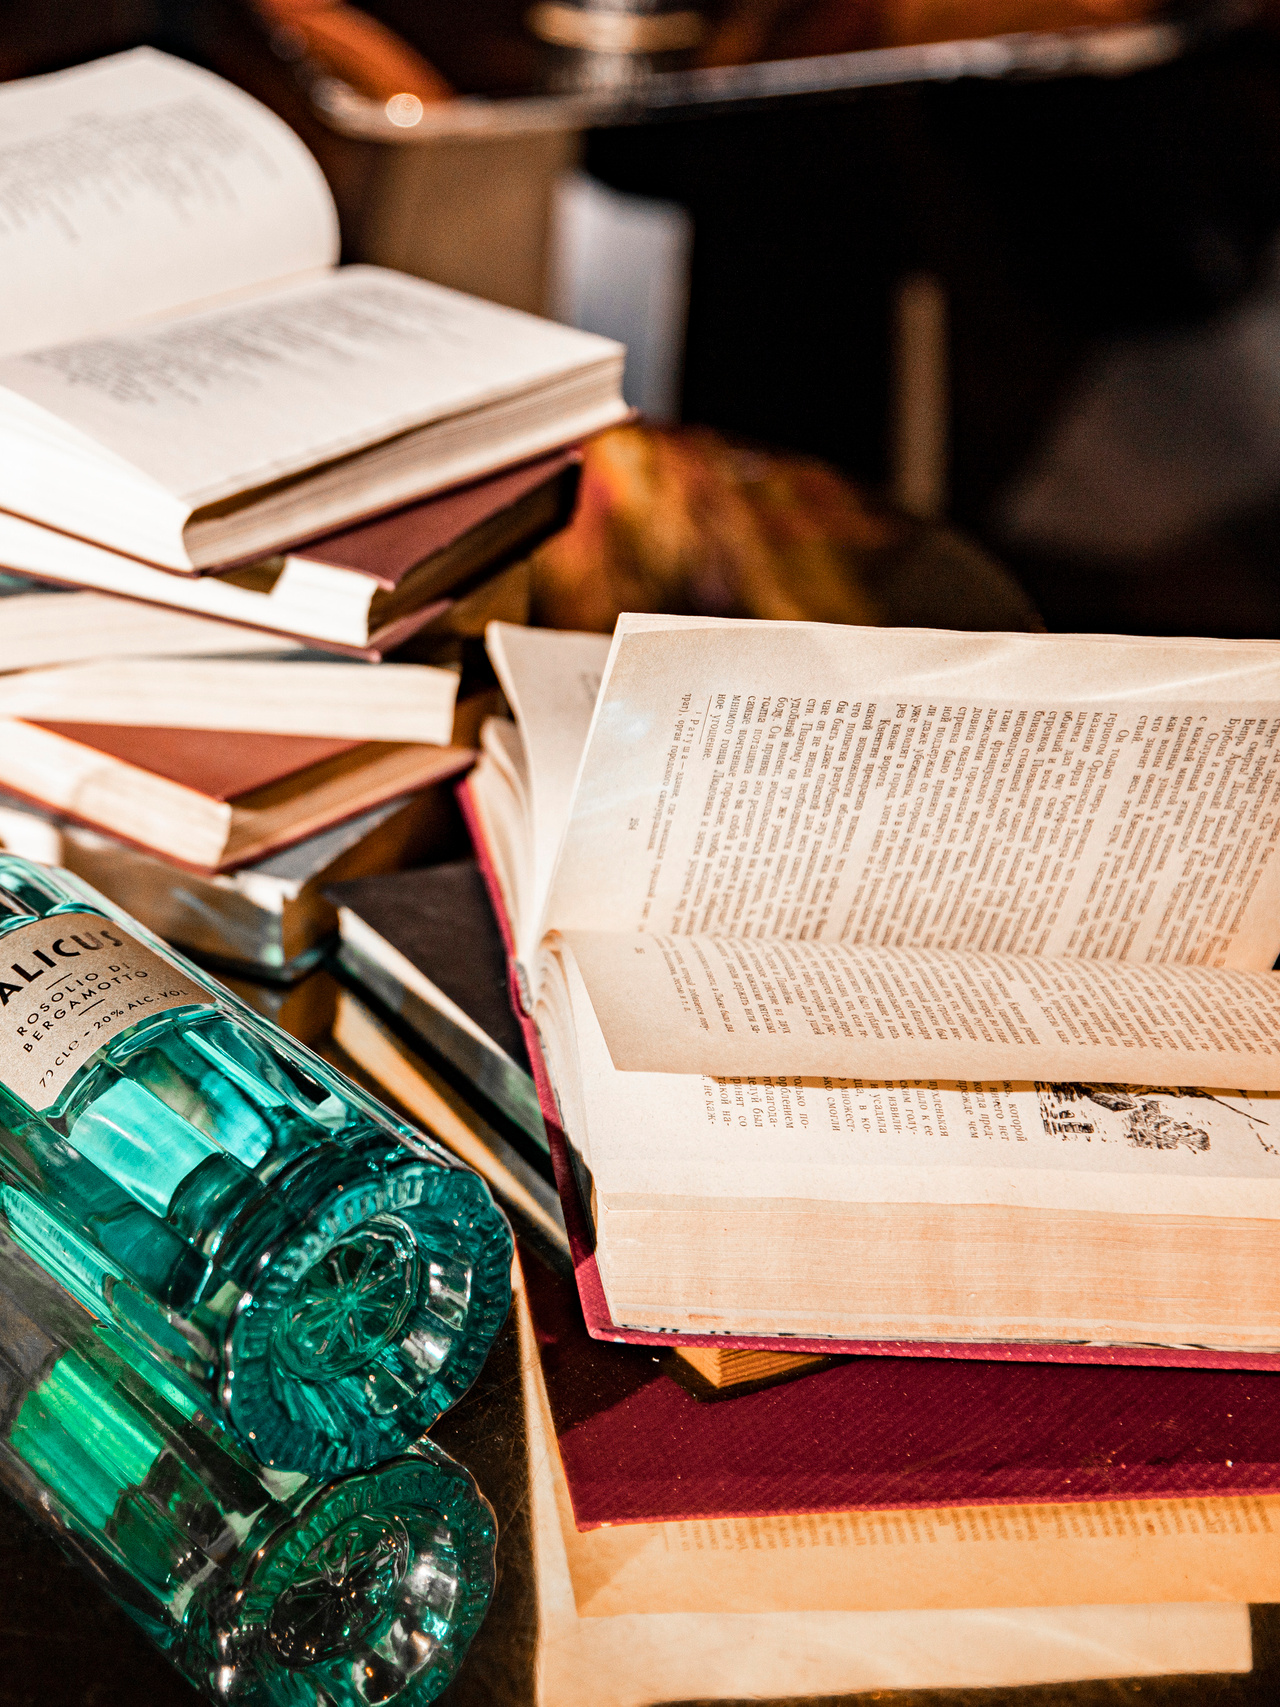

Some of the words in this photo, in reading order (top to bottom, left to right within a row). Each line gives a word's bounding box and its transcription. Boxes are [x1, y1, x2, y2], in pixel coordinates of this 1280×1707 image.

[715, 693, 726, 710] ное
[724, 695, 742, 734] мнимого
[741, 695, 756, 724] самые
[757, 696, 772, 723] толпа
[805, 698, 817, 714] сти.
[820, 699, 832, 716] чае
[850, 702, 862, 718] что
[862, 703, 877, 731] какой
[895, 703, 908, 719] рез
[909, 704, 922, 723] уже
[940, 706, 953, 723] ной
[673, 720, 685, 741] орган
[783, 698, 802, 737] удобный
[828, 718, 844, 741] быть
[918, 720, 932, 745] даже
[949, 706, 967, 743] стрелка
[965, 707, 983, 741] довика
[998, 709, 1013, 732] тами
[1025, 710, 1046, 743] близко
[1036, 710, 1058, 753] стрелков.
[1051, 710, 1073, 753] обычный
[1069, 711, 1088, 743] шлема
[1082, 712, 1103, 753] казанию
[1131, 715, 1148, 743] ствий.
[1151, 716, 1164, 732] что
[1165, 715, 1179, 733] как
[1235, 718, 1257, 747] Вепрь
[1254, 718, 1268, 736] или
[702, 715, 721, 760] угощение.
[792, 723, 813, 762] Поэтому
[838, 723, 856, 761] попытка
[869, 719, 891, 758] Квентин
[886, 724, 902, 750] какие
[899, 727, 916, 759] входят
[974, 708, 998, 761] льежскими
[1000, 710, 1028, 773] недовольство
[1095, 712, 1118, 756] герцогом
[1165, 716, 1193, 771] отдаленных
[1183, 727, 1204, 762] каждой
[1215, 718, 1242, 757] Бурбона
[716, 739, 730, 765] гонца
[728, 729, 748, 777] почтенные
[743, 729, 763, 774] потащила
[758, 743, 774, 776] принял
[803, 751, 817, 778] видел
[820, 744, 834, 770] даже
[923, 727, 946, 778] поддержки
[940, 749, 956, 774] было
[952, 746, 971, 782] оказать
[1062, 750, 1074, 766] дал
[1102, 749, 1120, 780] только
[1137, 738, 1156, 769] значит
[1152, 739, 1170, 768] волны
[1186, 732, 1219, 792] Оглушенный
[1239, 741, 1259, 775] смерть!
[843, 737, 867, 798] возможности
[875, 755, 892, 787] ворота.
[975, 740, 1005, 804] французского
[1009, 748, 1030, 792] стоявшей
[1038, 769, 1053, 790] всем
[1054, 773, 1066, 789] ему
[1069, 759, 1086, 787] лорда
[1203, 772, 1215, 787] его
[1245, 756, 1268, 794] храбрый
[1017, 759, 1045, 809] Появление
[1127, 775, 1141, 794] весь
[1167, 768, 1187, 805] минутой
[1224, 781, 1245, 810] Долой
[16, 971, 99, 1037] ROSOLIO
[108, 962, 130, 972] DI
[23, 970, 148, 1053] BERGAMOTTO
[93, 1009, 124, 1030] 20%
[758, 1004, 776, 1034] мятежных
[778, 1020, 791, 1034] двух
[704, 1085, 713, 1096] не
[718, 1076, 731, 1104] такой
[776, 1076, 794, 1128] орблением
[973, 1082, 987, 1108] когда
[706, 1100, 716, 1124] каж-
[722, 1110, 732, 1126] на-
[738, 1116, 748, 1127] со
[753, 1108, 763, 1127] был
[799, 1113, 809, 1129] по-
[827, 1097, 841, 1131] смогли
[839, 1086, 856, 1132] множест-
[869, 1094, 888, 1133] усадила
[888, 1096, 902, 1134] извили-
[905, 1109, 917, 1134] голу-
[916, 1090, 928, 1110] шло
[924, 1125, 934, 1136] ее
[927, 1081, 949, 1136] пухленькая
[956, 1080, 974, 1115] прежде
[968, 1121, 979, 1138] чем
[989, 1087, 1004, 1119] ничего
[998, 1125, 1010, 1141] нет
[1008, 1103, 1028, 1142] которой
[861, 1117, 871, 1132] ко-
[979, 1114, 994, 1140] пред-
